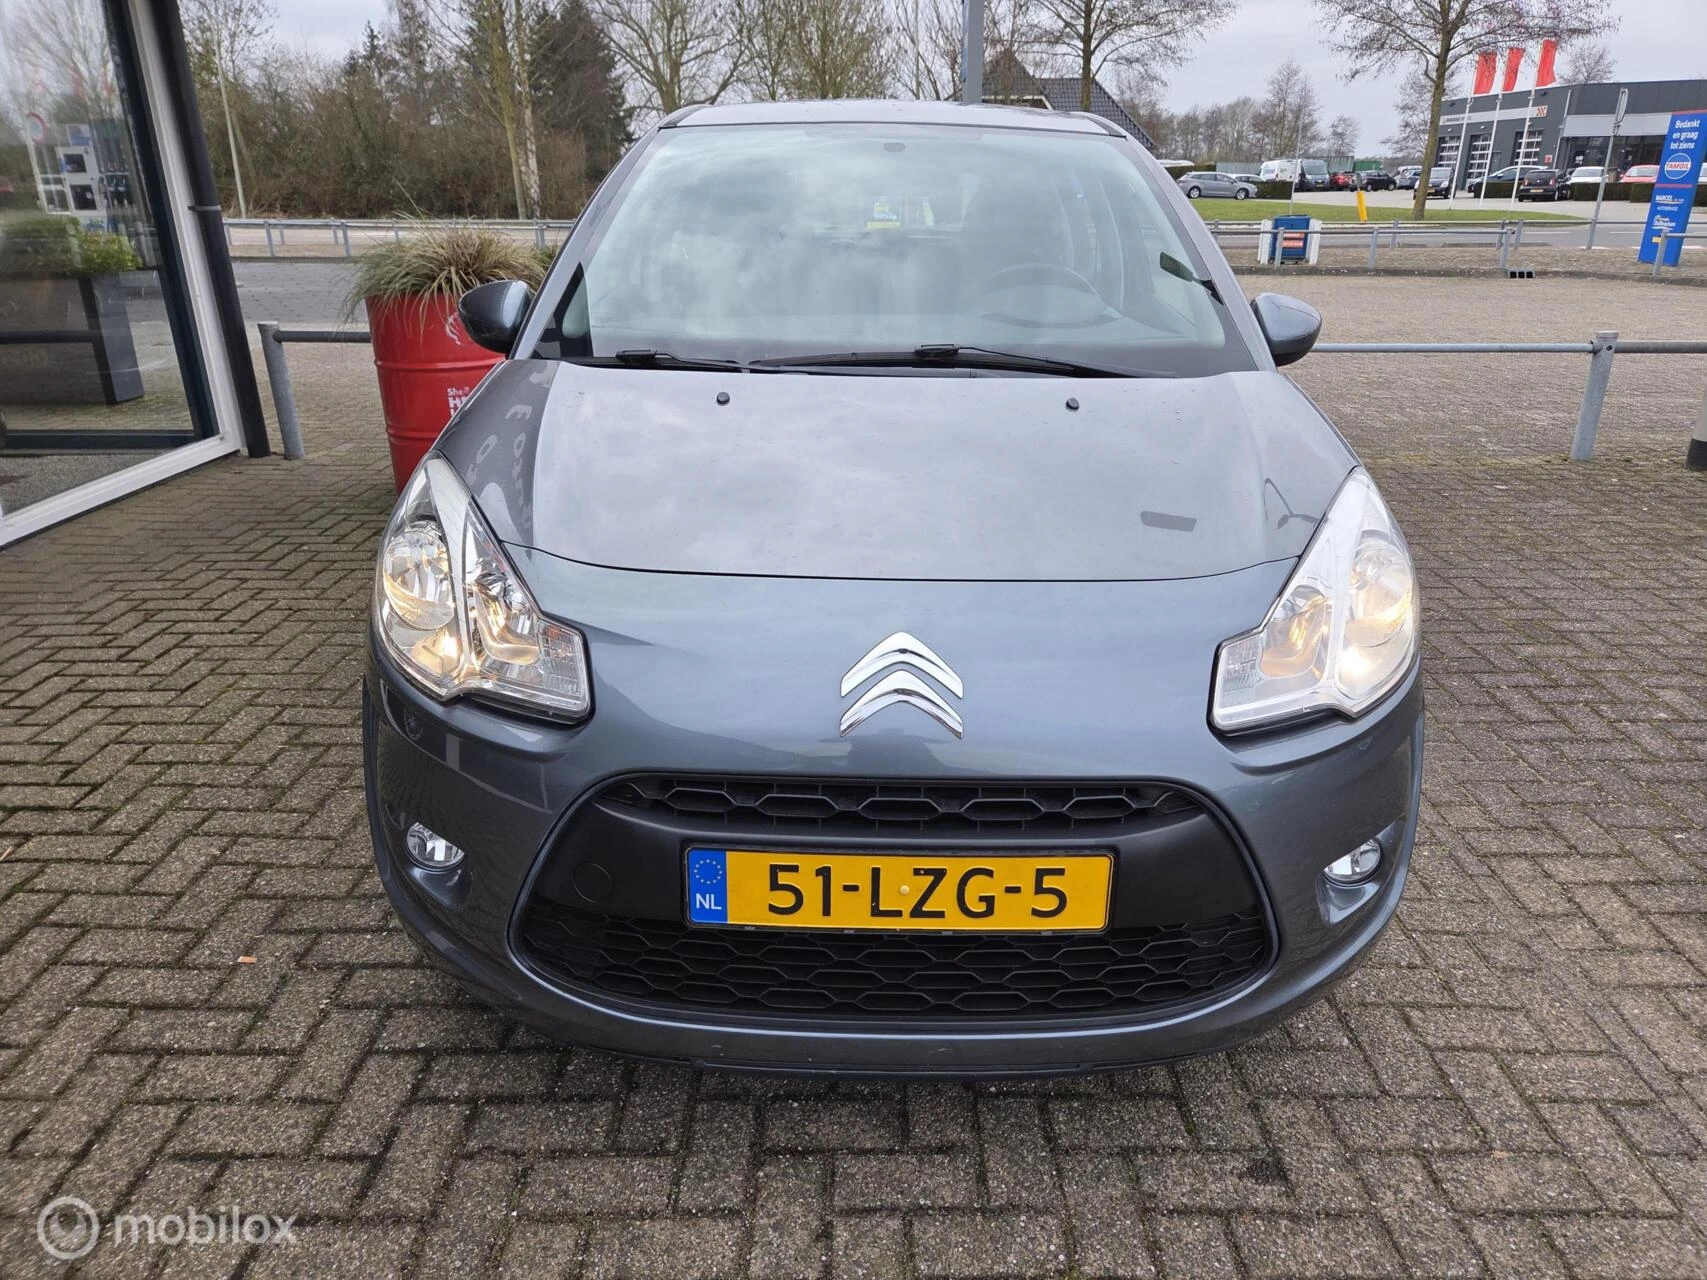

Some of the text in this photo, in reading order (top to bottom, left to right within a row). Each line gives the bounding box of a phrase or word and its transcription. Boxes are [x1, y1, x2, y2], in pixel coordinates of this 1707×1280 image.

[1675, 119, 1700, 128] Bedankt
[1680, 131, 1699, 141] graag
[1670, 141, 1695, 149] tot ziens
[447, 386, 469, 396] Shell
[767, 863, 1068, 919] 51-LZG-5
[695, 892, 722, 911] NL
